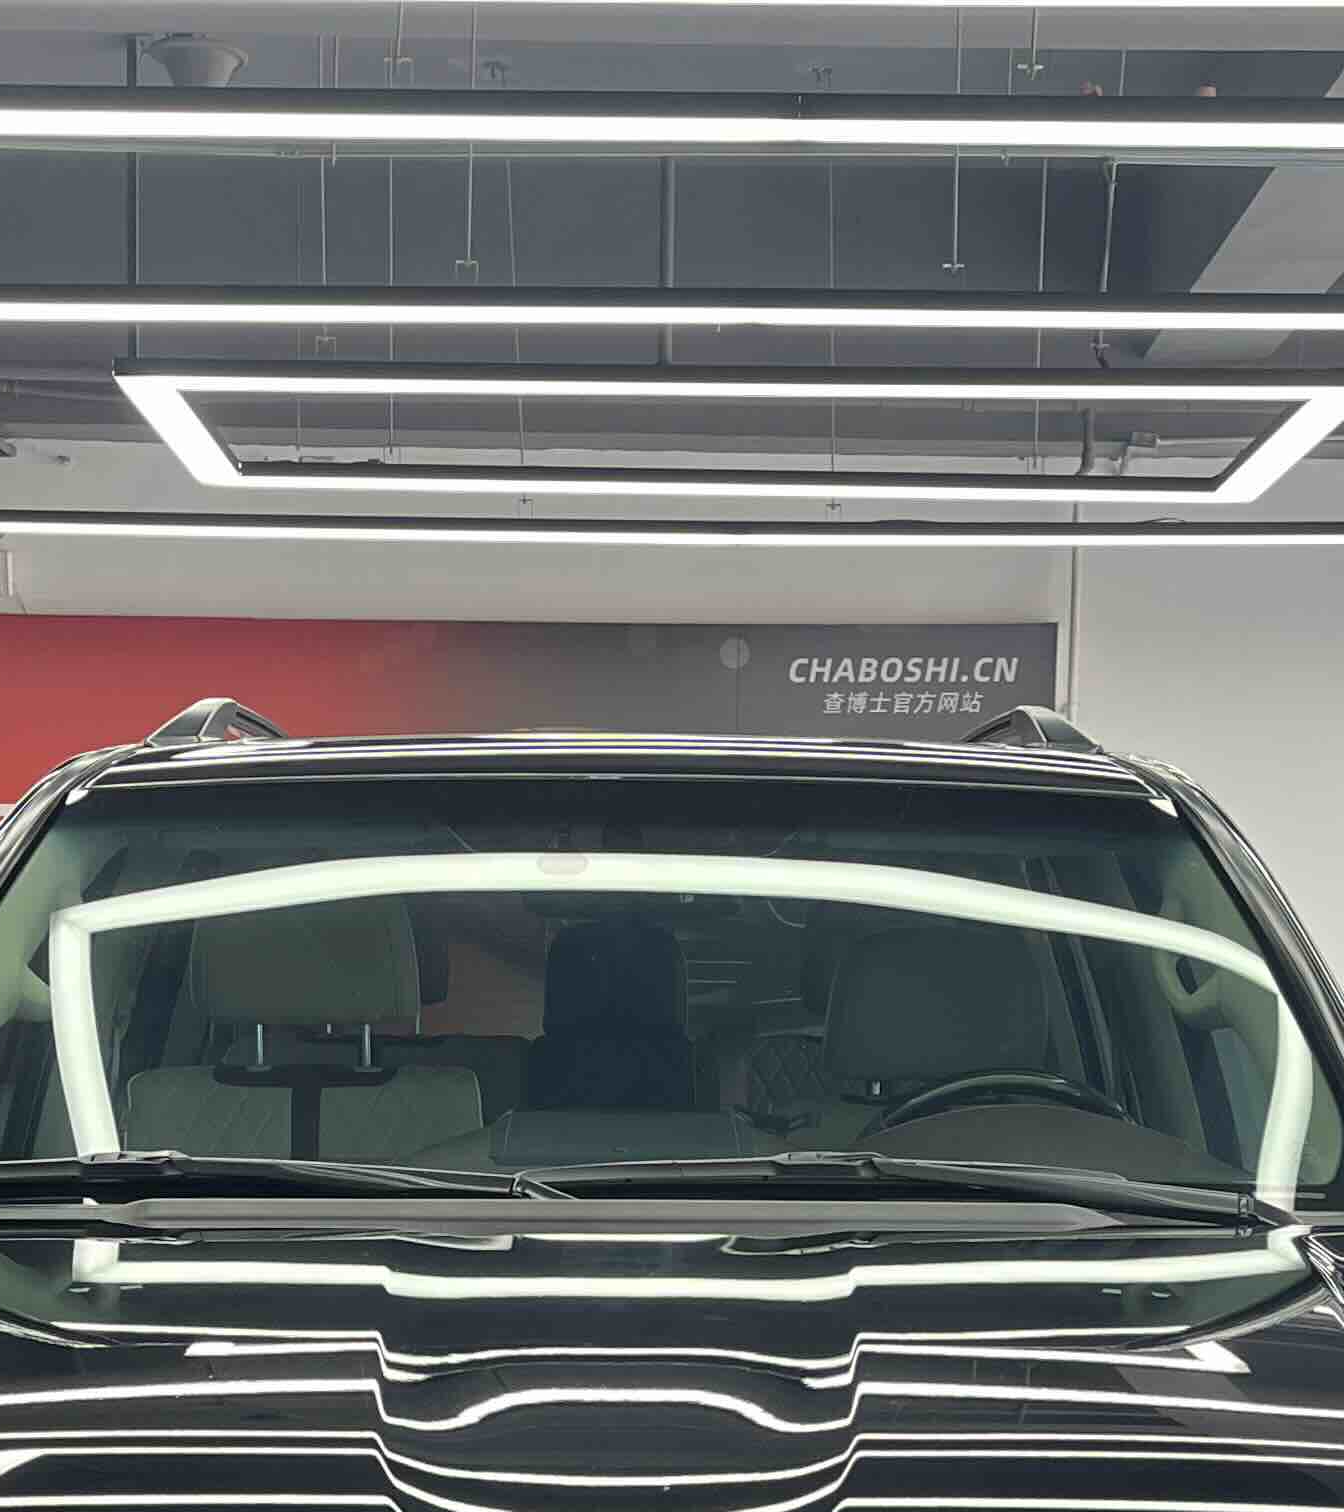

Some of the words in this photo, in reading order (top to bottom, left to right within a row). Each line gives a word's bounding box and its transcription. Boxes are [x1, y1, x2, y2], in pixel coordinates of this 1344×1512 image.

[788, 656, 1019, 684] CHABOSHI.CN
[823, 692, 984, 715] 查博士官方网站
